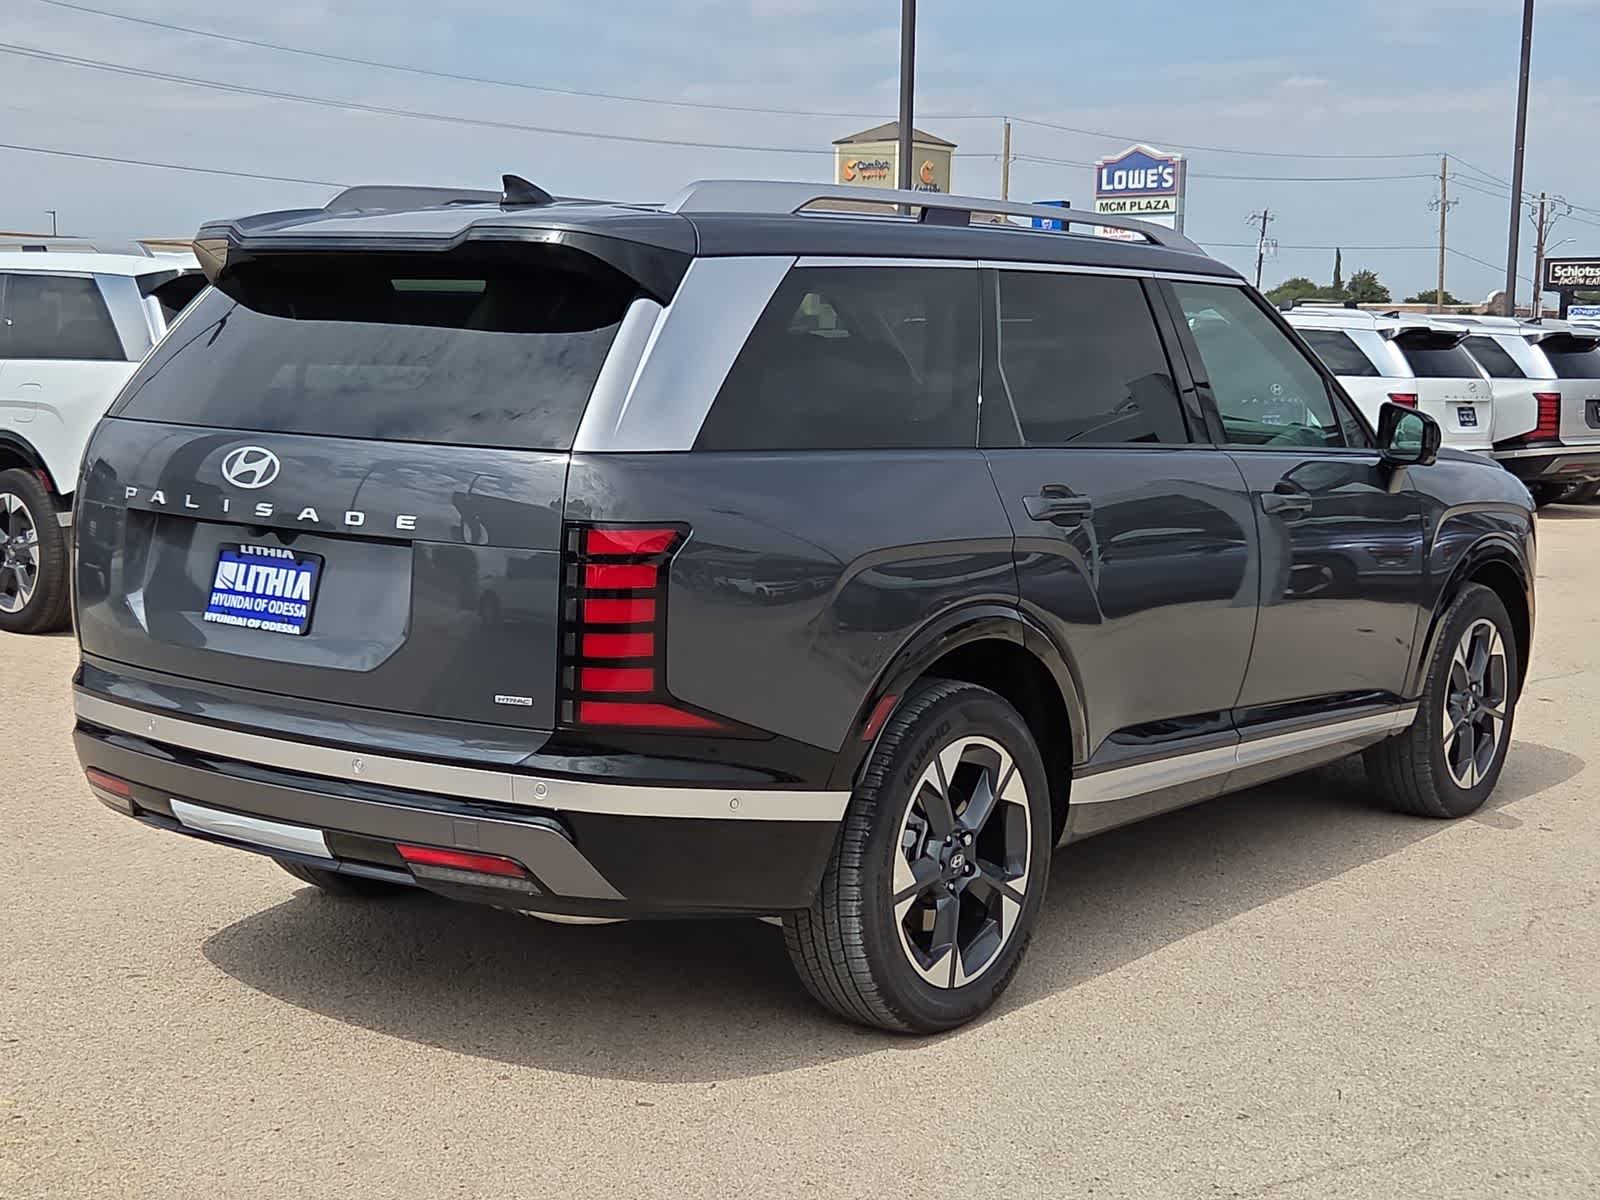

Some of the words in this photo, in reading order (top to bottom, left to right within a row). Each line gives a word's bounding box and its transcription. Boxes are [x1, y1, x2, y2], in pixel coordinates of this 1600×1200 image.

[1101, 165, 1174, 191] LOWE'S
[1099, 201, 1127, 212] MCM
[1129, 199, 1170, 211] PLAZA
[125, 486, 417, 530] PALISADE
[240, 544, 295, 560] LITHIA
[234, 563, 311, 601] LITHIA
[210, 592, 254, 610] HYUNDAI
[254, 598, 269, 612] OF
[268, 600, 307, 618] ODESSA
[203, 611, 247, 627] HYUNDAI
[247, 618, 261, 629] OF
[261, 620, 301, 635] ODESSA
